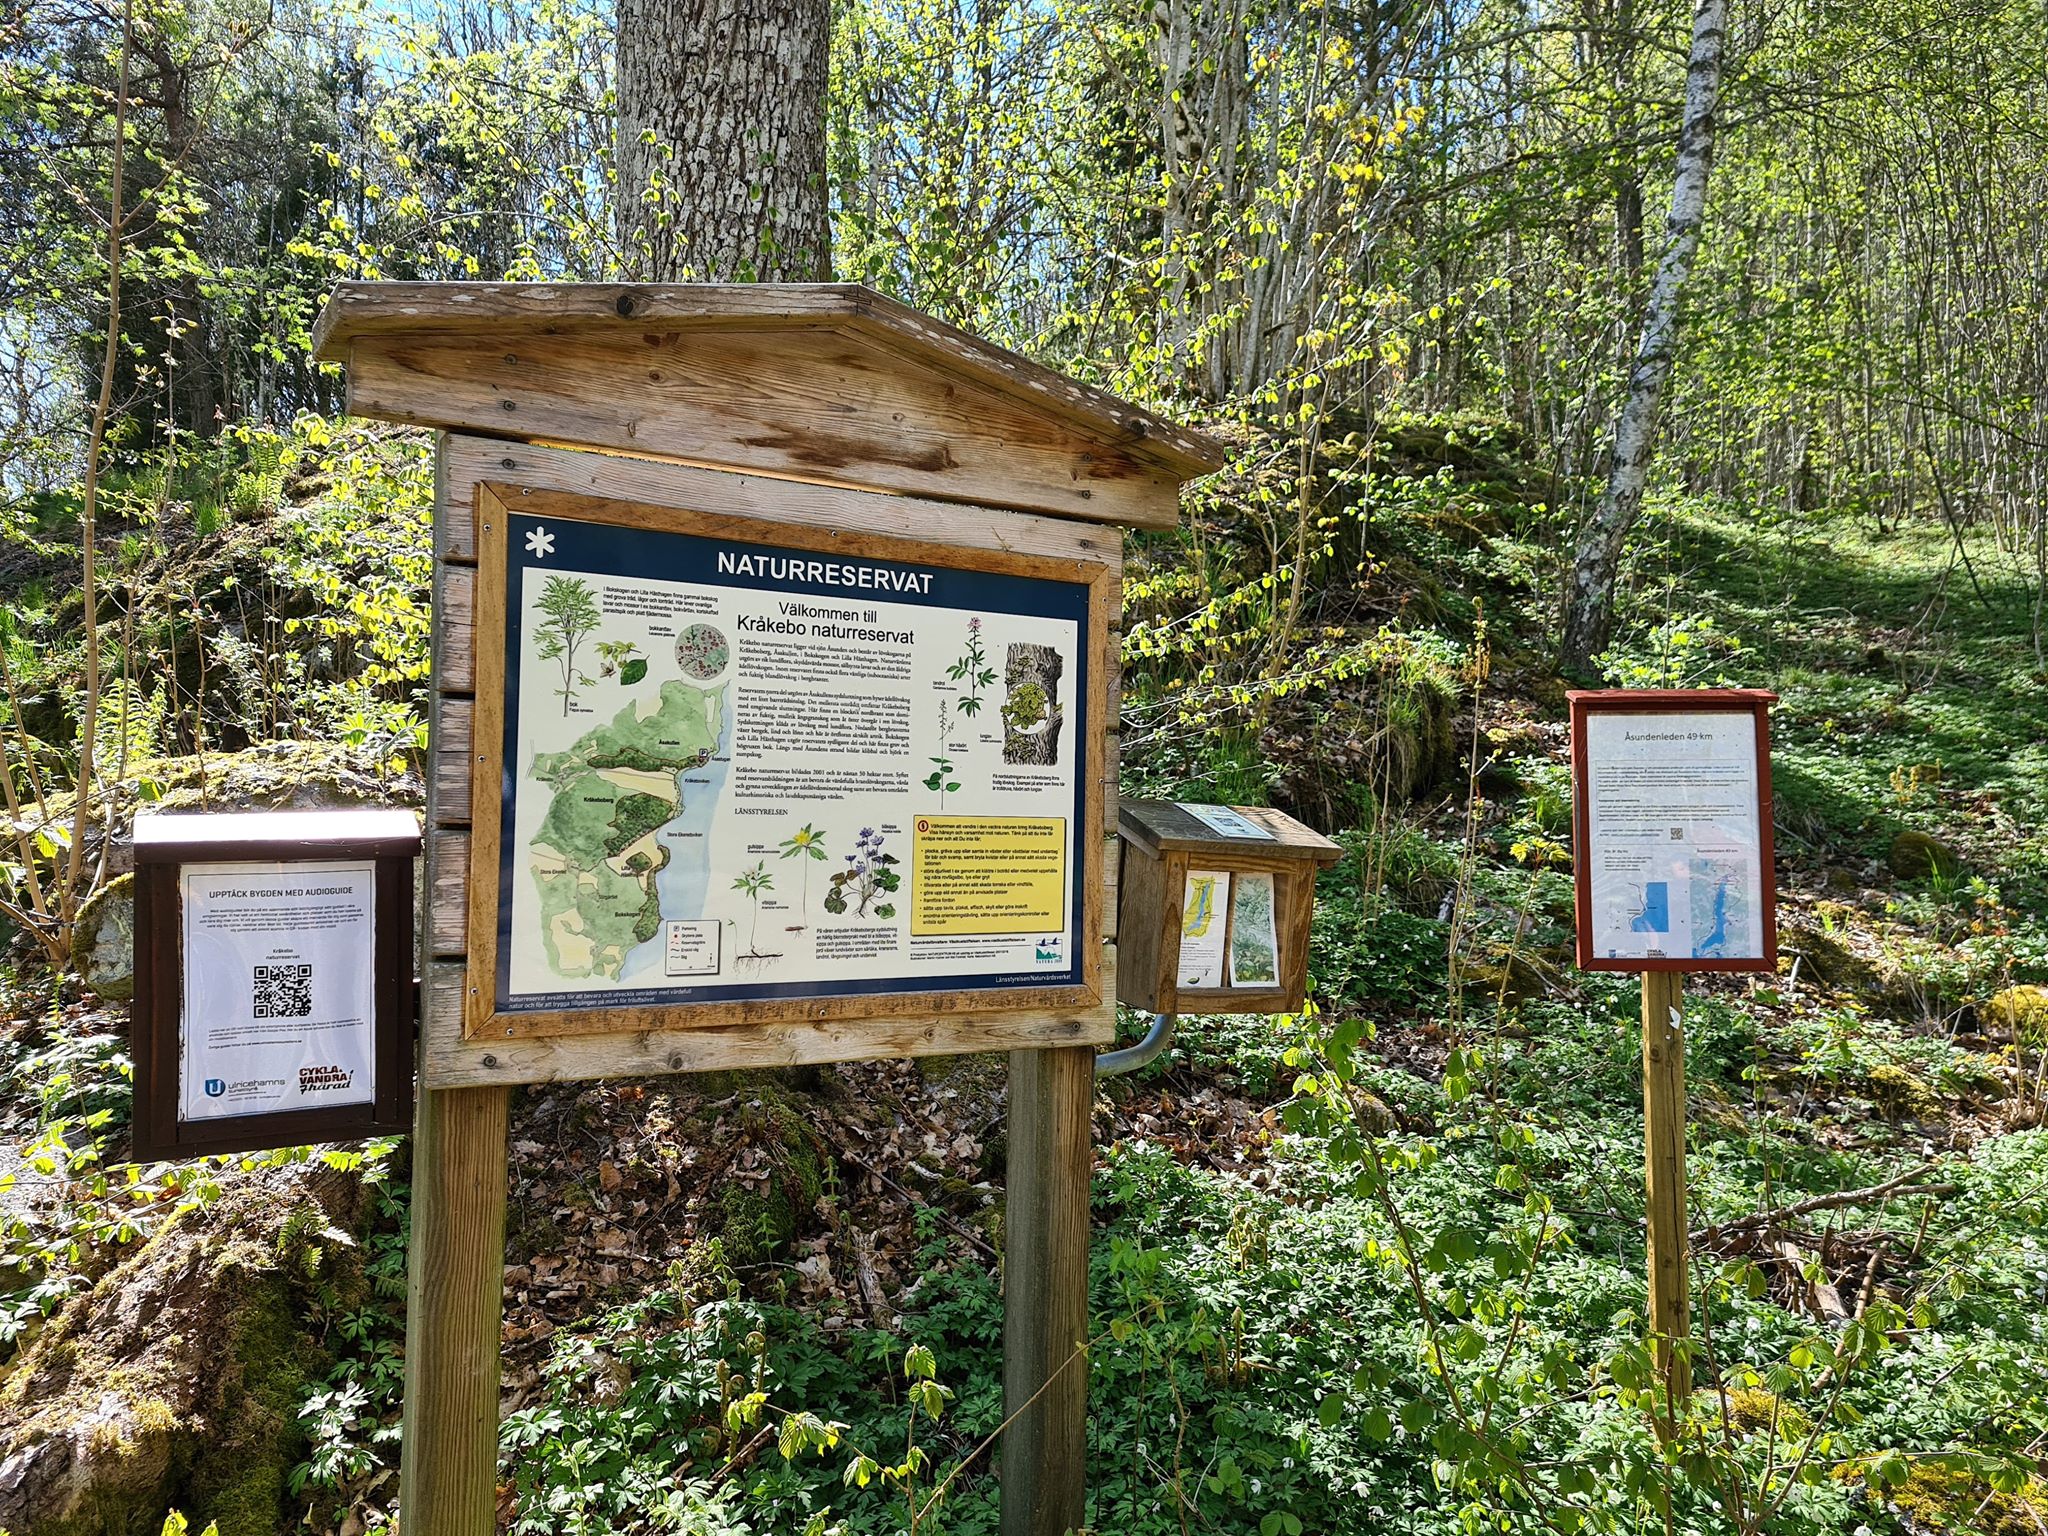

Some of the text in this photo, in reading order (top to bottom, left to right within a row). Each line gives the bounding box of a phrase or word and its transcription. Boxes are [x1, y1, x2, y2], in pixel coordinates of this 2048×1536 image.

[717, 551, 934, 594] NATURRESERVAT
[778, 601, 877, 623] Välkommen till
[738, 614, 914, 644] Kråkebo naturreservat
[1625, 731, 1685, 741] Åsundenleden
[209, 888, 248, 898] UPPTÄCK
[305, 886, 353, 896] AUDIOGUIDE
[228, 1079, 286, 1089] ulricehamns
[300, 1081, 351, 1095] 7härad
